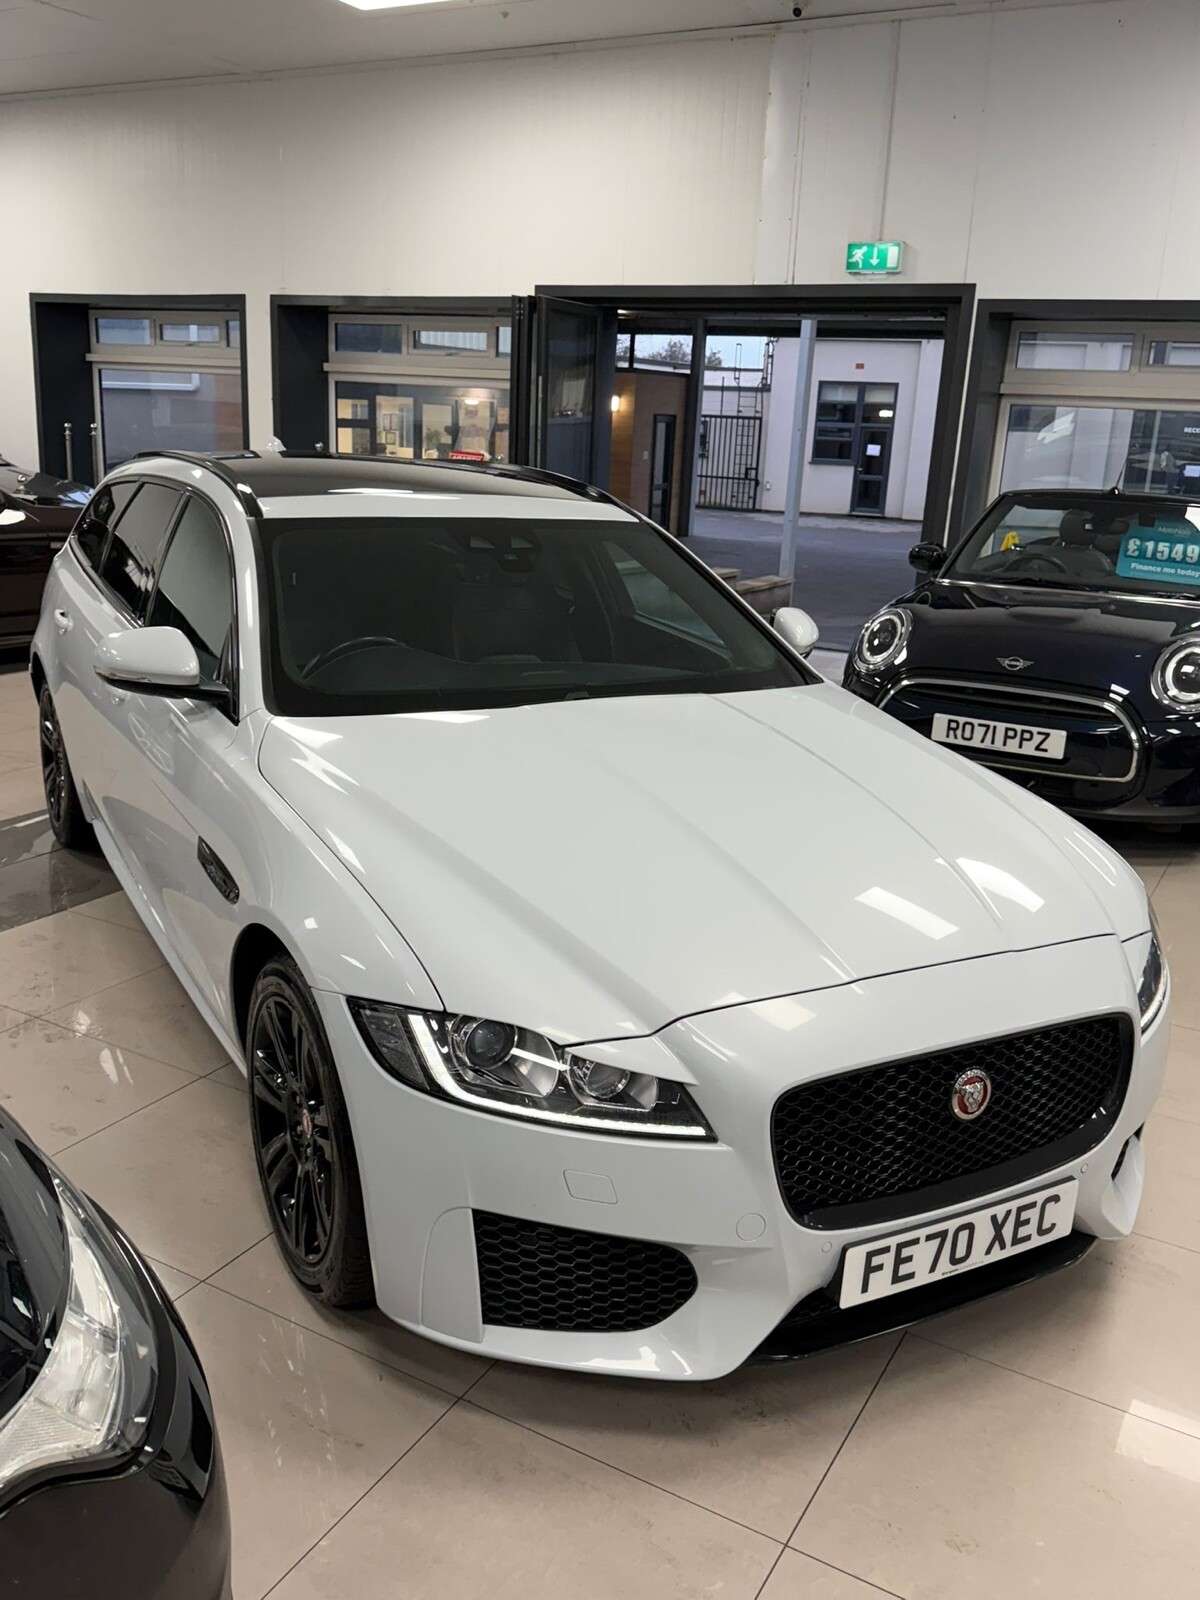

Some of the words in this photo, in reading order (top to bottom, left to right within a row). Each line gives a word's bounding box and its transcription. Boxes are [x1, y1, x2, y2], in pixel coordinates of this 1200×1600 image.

[1130, 562, 1161, 573] Finance
[1177, 568, 1200, 578] today
[945, 718, 997, 745] RO71
[1002, 726, 1051, 753] PPZ
[860, 1221, 976, 1294] FE70
[984, 1193, 1062, 1256] XEC
